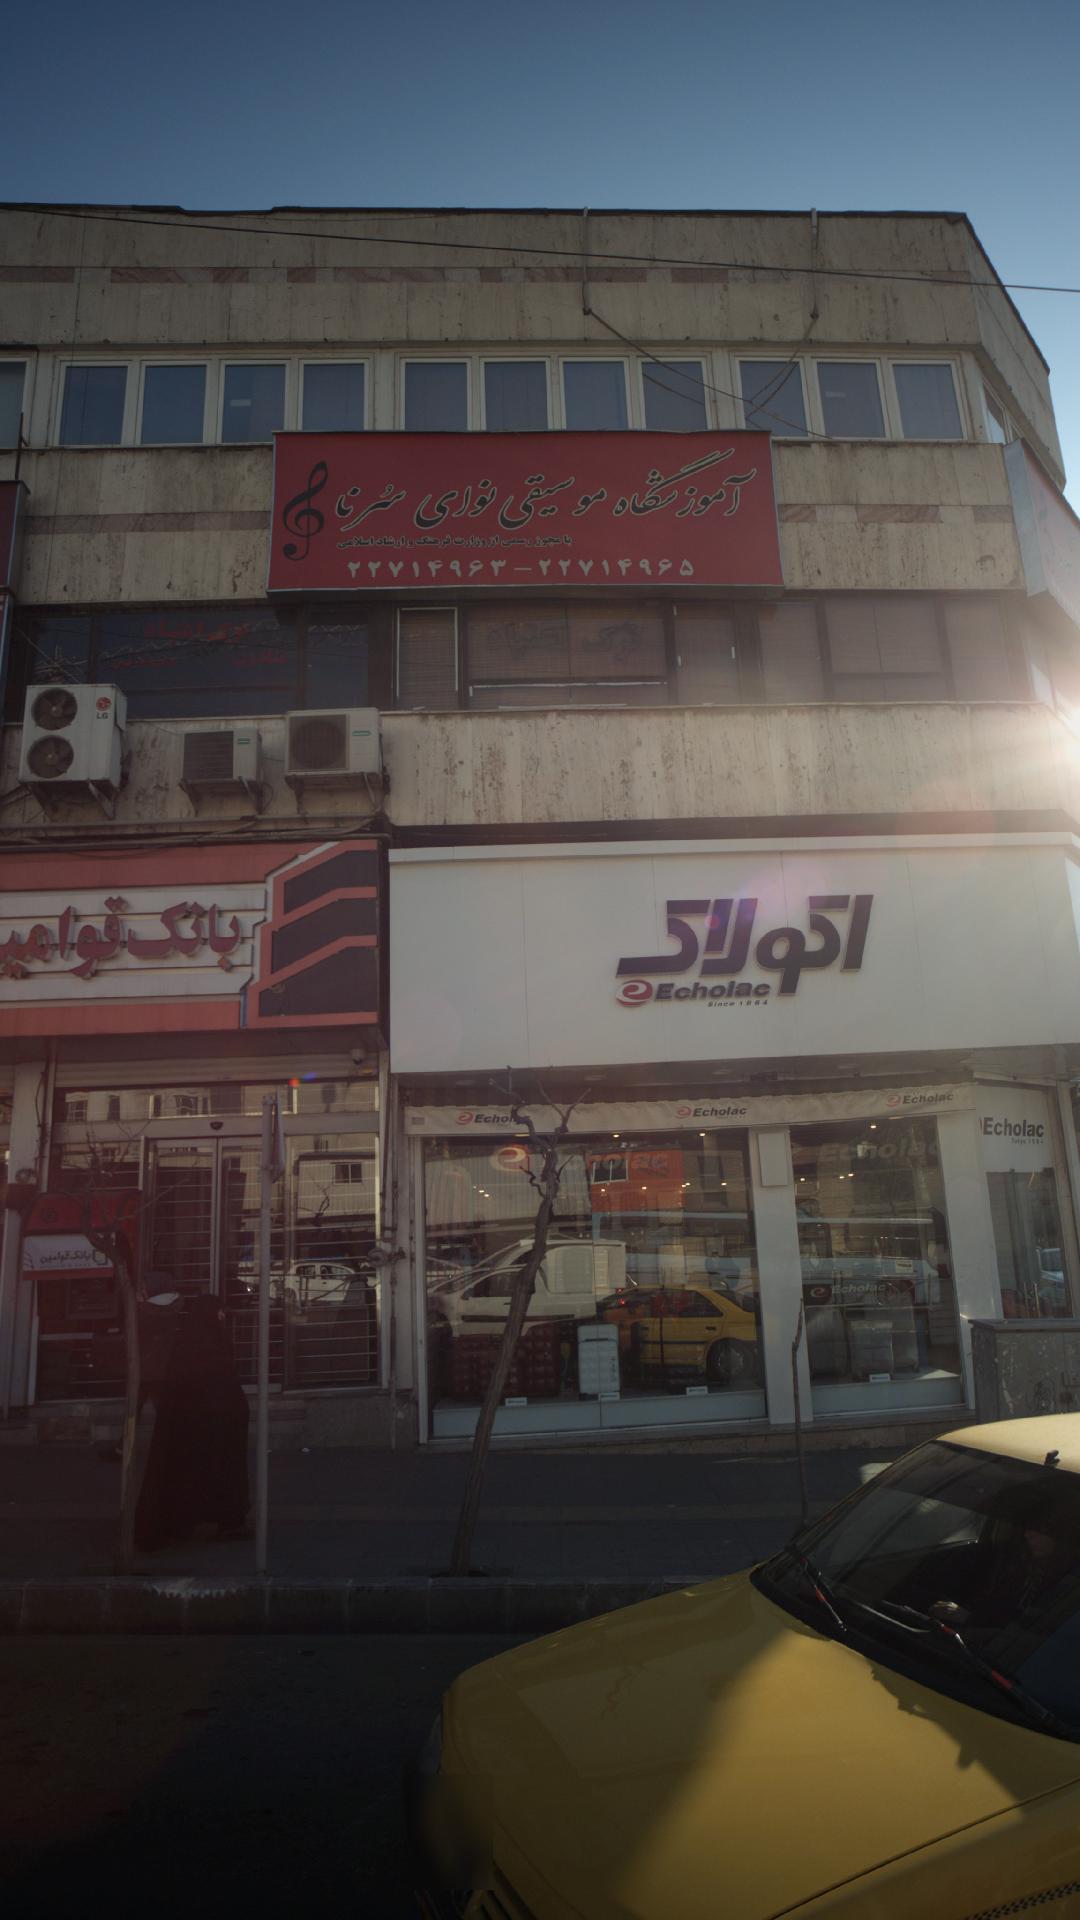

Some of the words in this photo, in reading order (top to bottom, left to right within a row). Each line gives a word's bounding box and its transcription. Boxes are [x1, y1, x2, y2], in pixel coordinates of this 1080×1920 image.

[612, 447, 758, 518] آموزشگاه
[414, 479, 498, 530] نوای
[499, 474, 607, 530] موسیقی
[336, 536, 375, 550] اسلامی
[533, 536, 561, 548] مجوز
[562, 535, 573, 546] با
[96, 712, 109, 720] LG
[0, 896, 129, 980] قوامی
[128, 900, 243, 973] بانک
[654, 980, 771, 1001] Echolac
[902, 1092, 954, 1105] Echolac
[692, 1106, 748, 1118] Echolac
[983, 1117, 1044, 1137] Echolac
